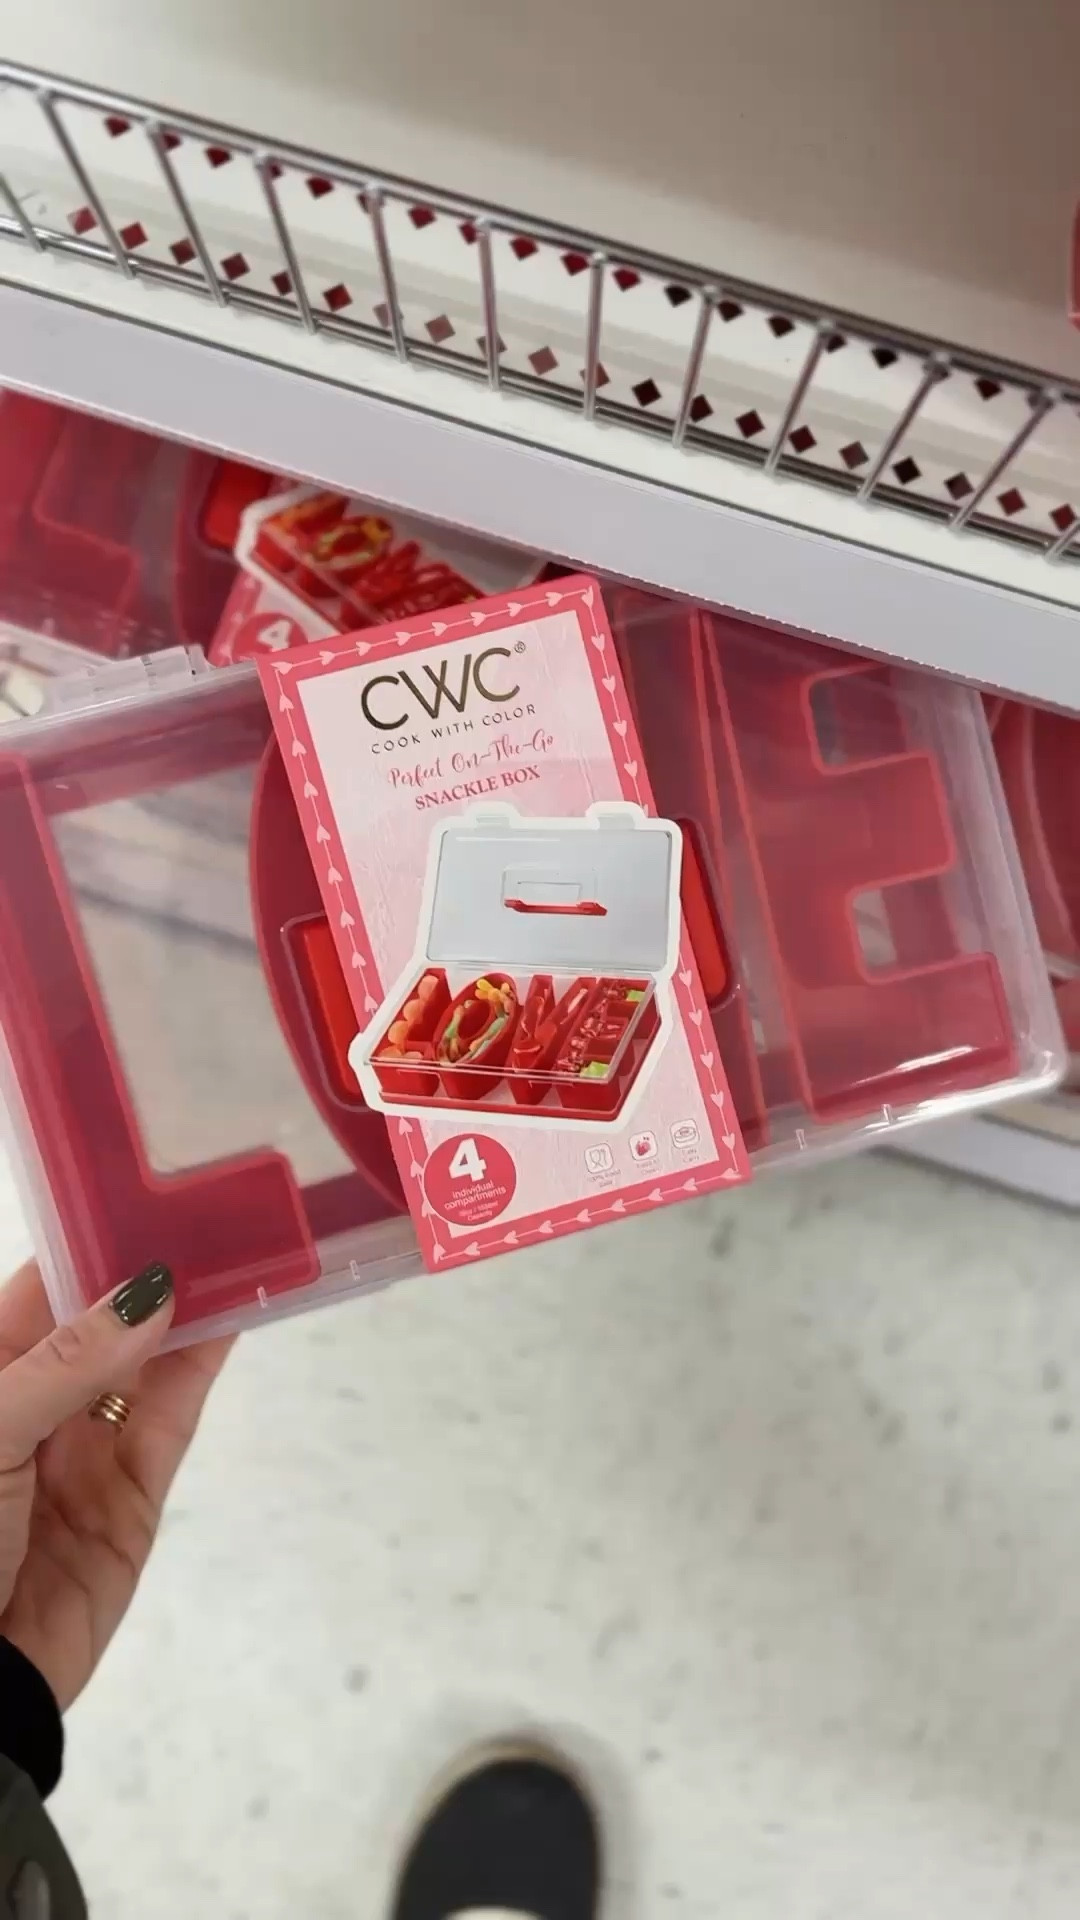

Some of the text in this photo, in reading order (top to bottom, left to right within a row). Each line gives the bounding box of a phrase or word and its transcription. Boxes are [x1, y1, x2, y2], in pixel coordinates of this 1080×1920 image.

[371, 704, 536, 754] COOK WITH COLOR
[387, 757, 443, 788] Perfect
[415, 765, 541, 810] SNACKLE BOX
[449, 1138, 487, 1182] 4
[443, 1186, 507, 1211] compartments
